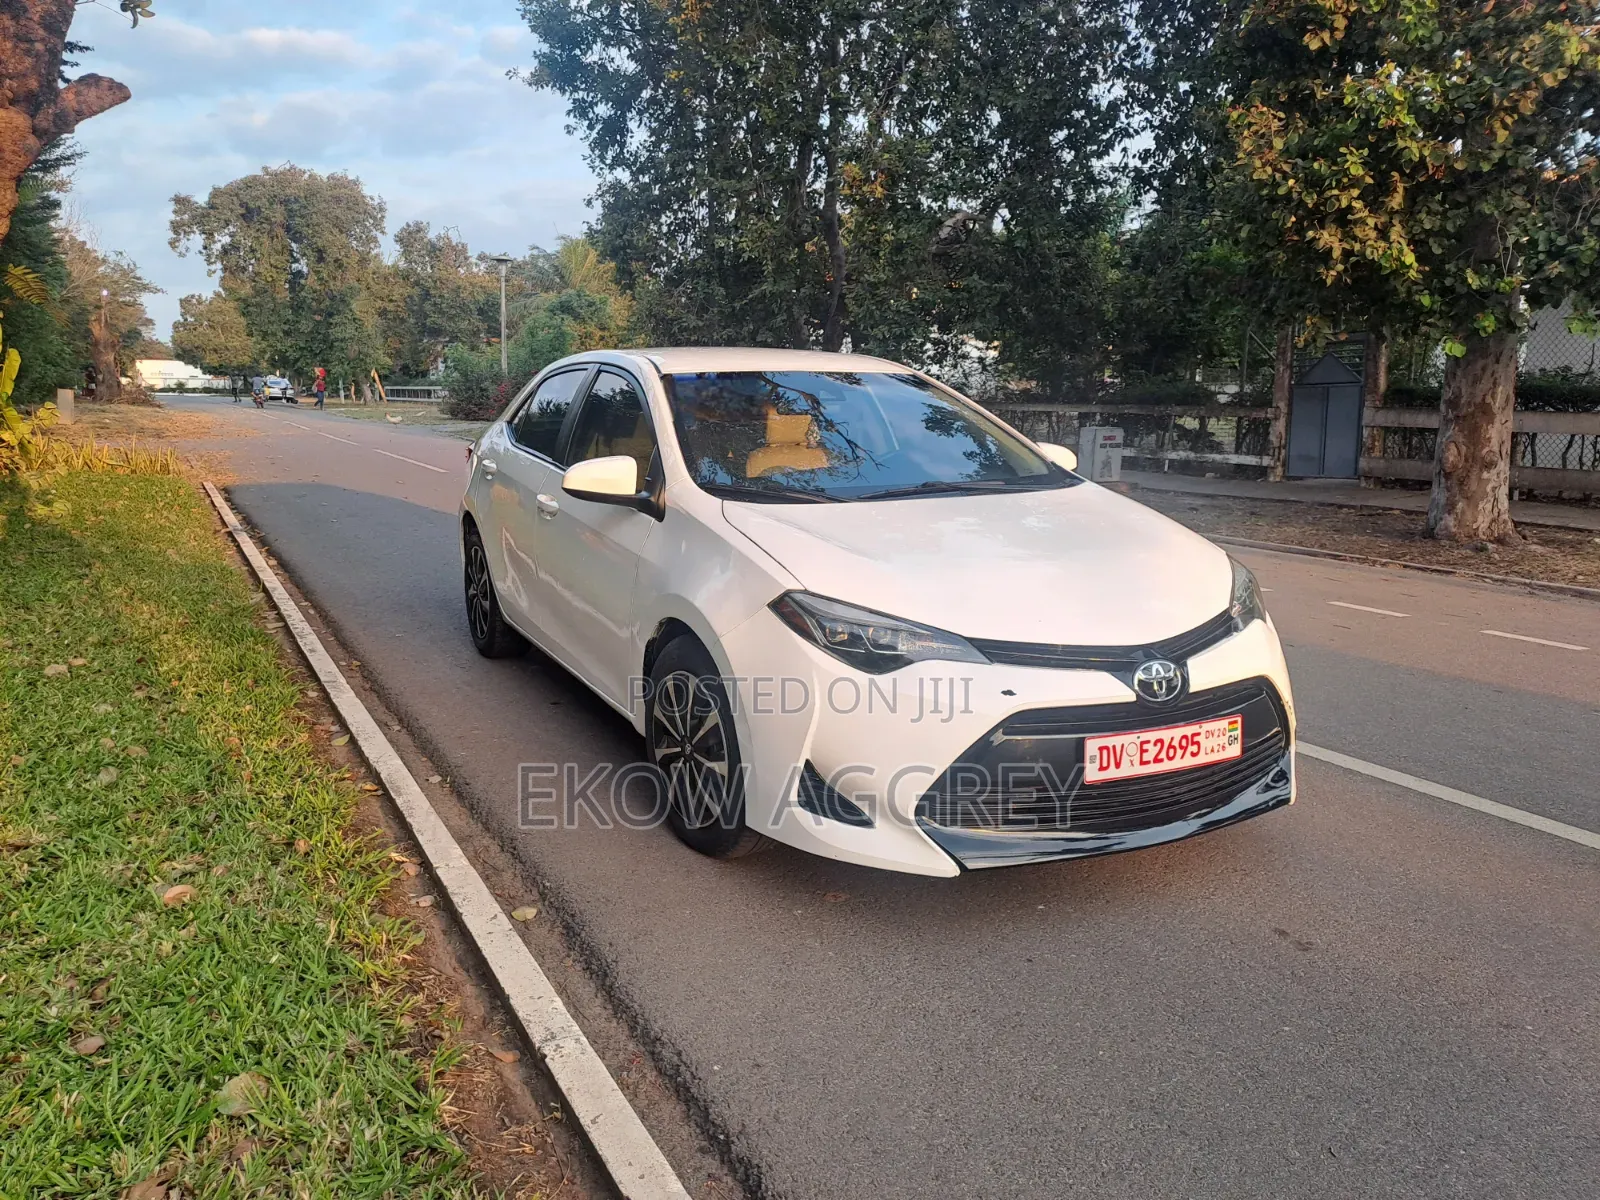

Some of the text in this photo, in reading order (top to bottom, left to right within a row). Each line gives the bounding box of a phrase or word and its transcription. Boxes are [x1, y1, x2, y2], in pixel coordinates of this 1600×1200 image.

[1097, 732, 1201, 772] DV E2695
[1227, 733, 1238, 746] GH
